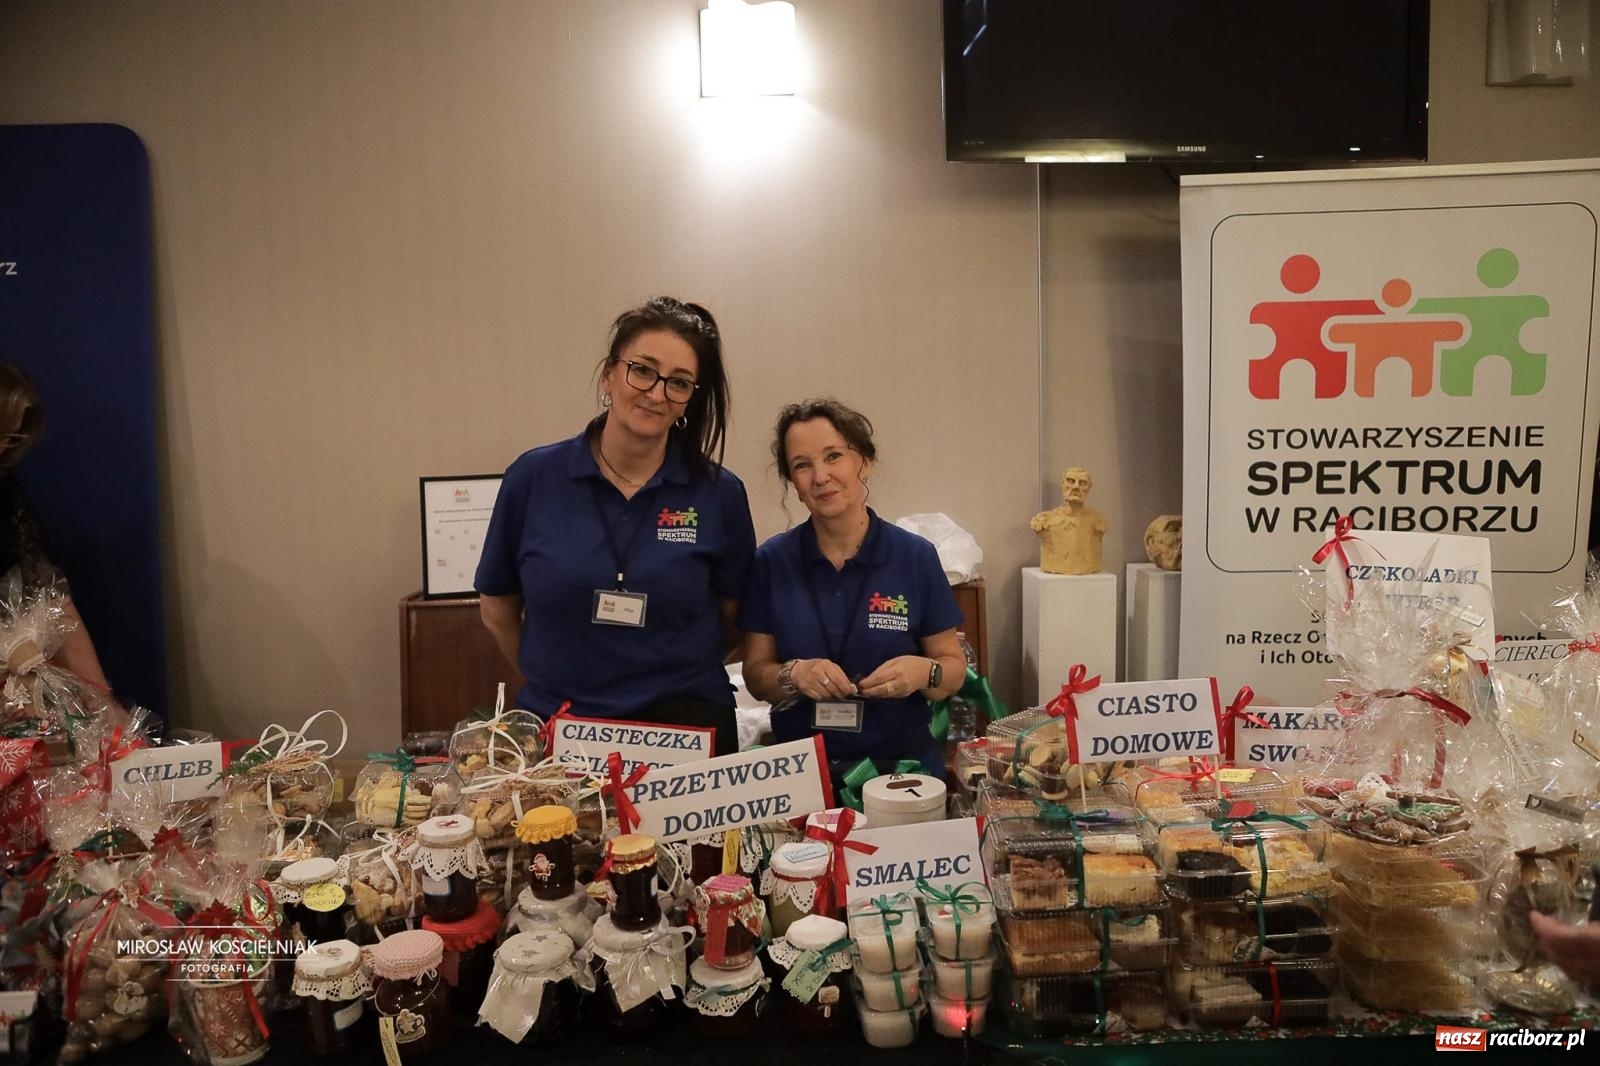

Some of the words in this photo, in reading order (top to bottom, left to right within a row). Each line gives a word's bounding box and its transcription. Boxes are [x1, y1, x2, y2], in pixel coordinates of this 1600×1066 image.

[1176, 145, 1207, 153] SAMSUNG
[1247, 426, 1545, 450] STOWARZYSZENIE
[1247, 459, 1542, 496] SPEKTRUM
[1245, 506, 1280, 533] W
[1293, 506, 1538, 533] RACIBORZU
[657, 531, 697, 539] SPEKTRUM
[868, 617, 909, 627] SPEKTRUM
[1226, 633, 1246, 644] na
[1251, 630, 1302, 644] Rzecz
[1260, 650, 1265, 664] i
[1270, 650, 1296, 664] Ich
[1098, 693, 1198, 717] CIASTO
[1242, 712, 1349, 731] MAKAR
[562, 724, 703, 750] CIASTECZKA
[1090, 729, 1214, 757] DOMOWE
[123, 759, 214, 785] CHLEB
[632, 752, 810, 804] PRZETWORY
[662, 793, 792, 837] DOMOWE
[855, 854, 971, 888] SMALEC
